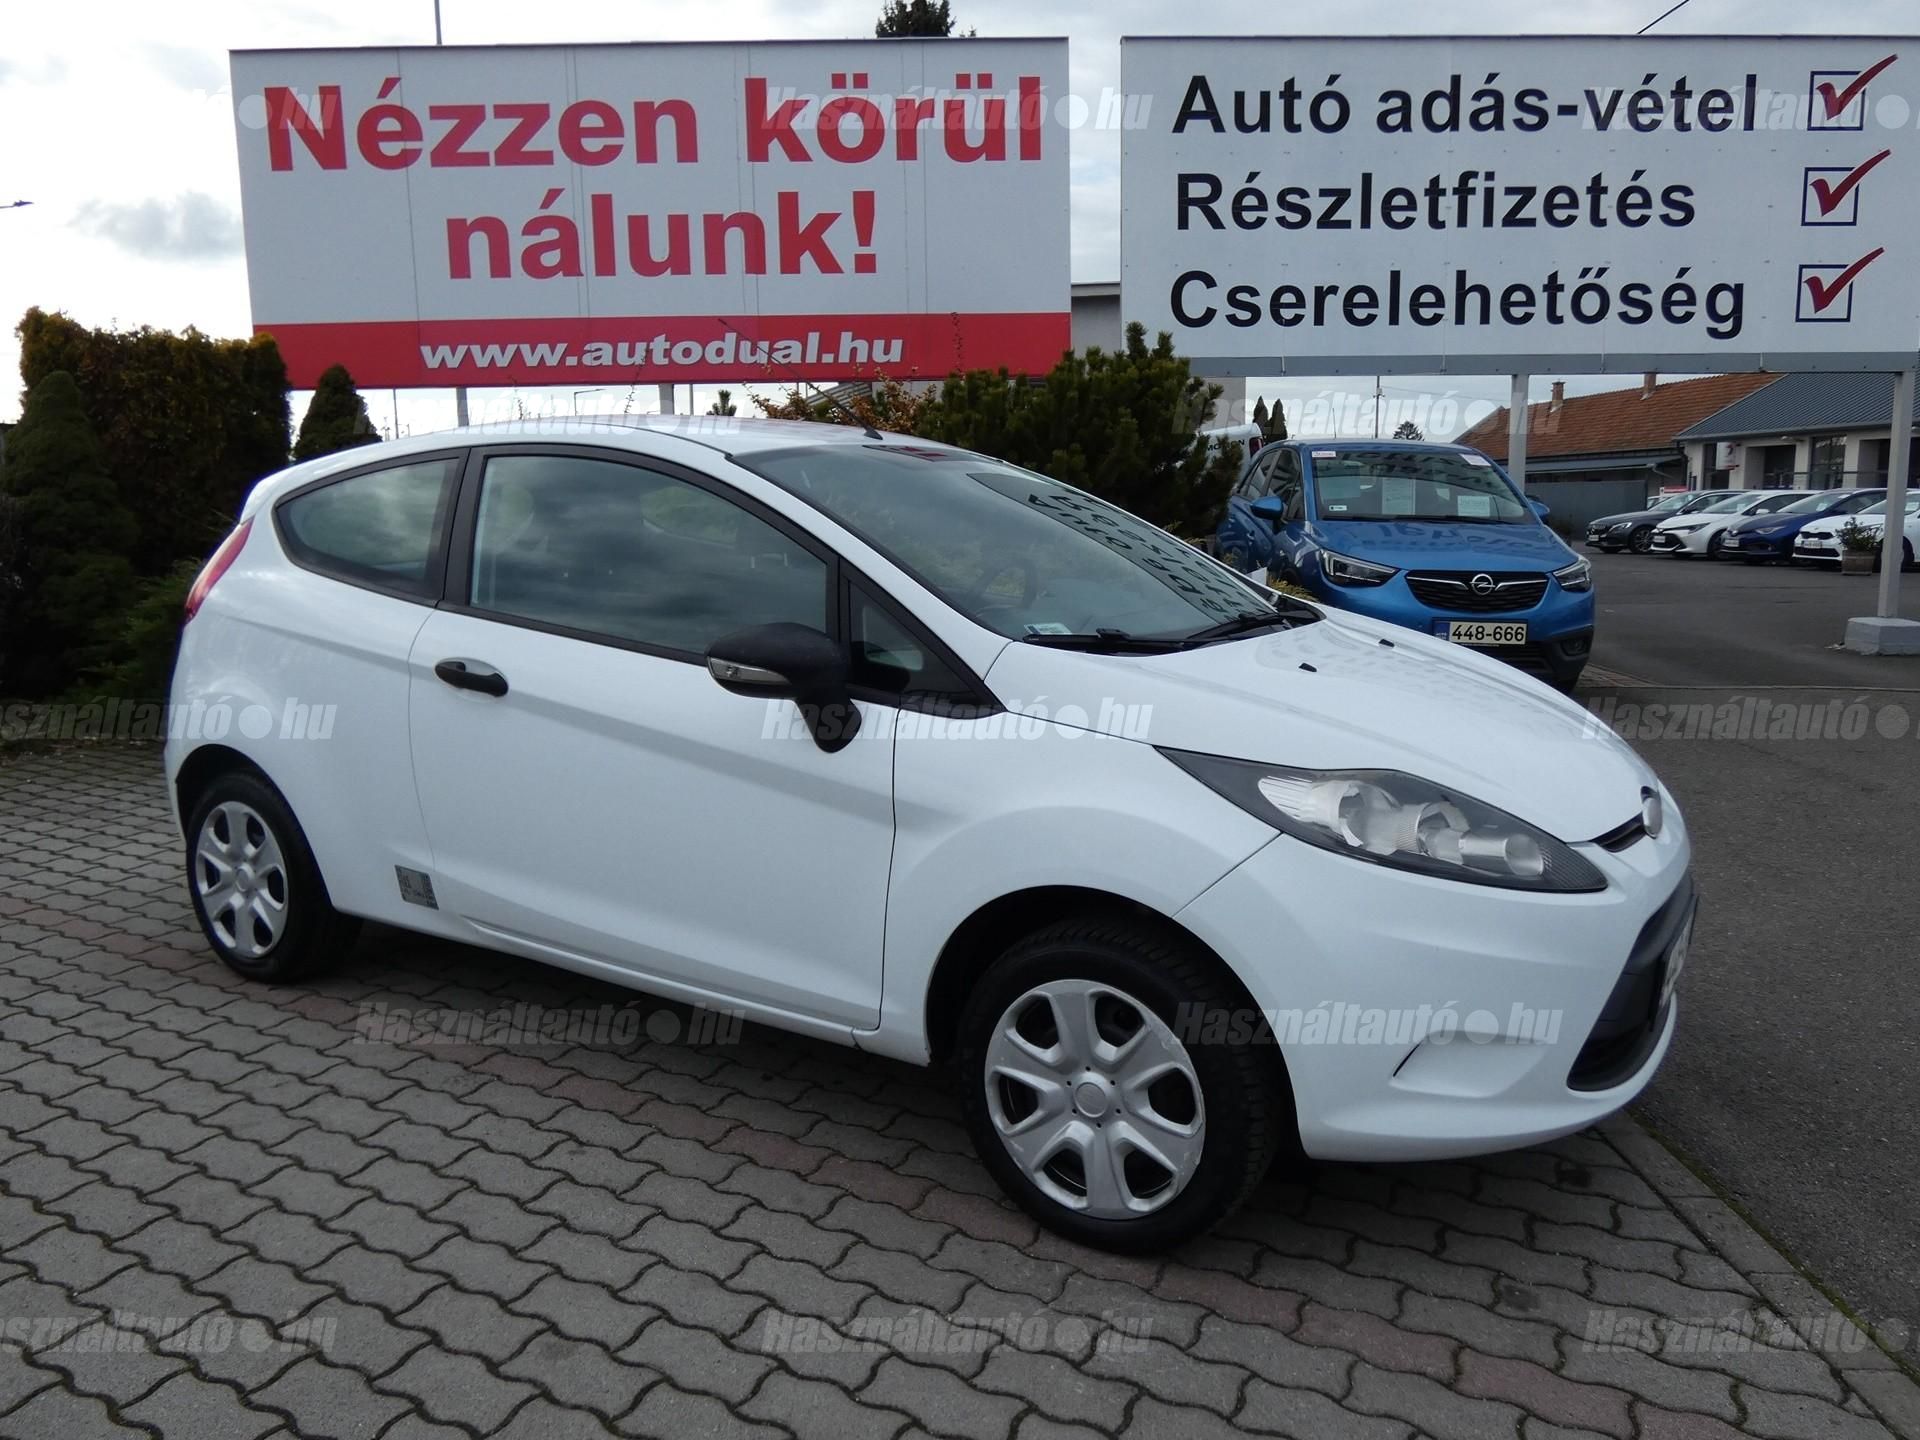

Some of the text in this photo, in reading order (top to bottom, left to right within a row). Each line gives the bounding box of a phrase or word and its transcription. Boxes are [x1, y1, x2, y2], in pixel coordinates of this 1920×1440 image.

[264, 77, 698, 171] Nézzen
[744, 73, 1042, 163] körül
[1172, 72, 1757, 134] Autó adás-vétel
[1176, 169, 1696, 231] Részletfizetés
[446, 188, 876, 279] nálunk!
[1169, 266, 1745, 340] Cserelehetőség
[421, 332, 903, 369] www.autodual.hu
[1451, 624, 1525, 642] 448-666
